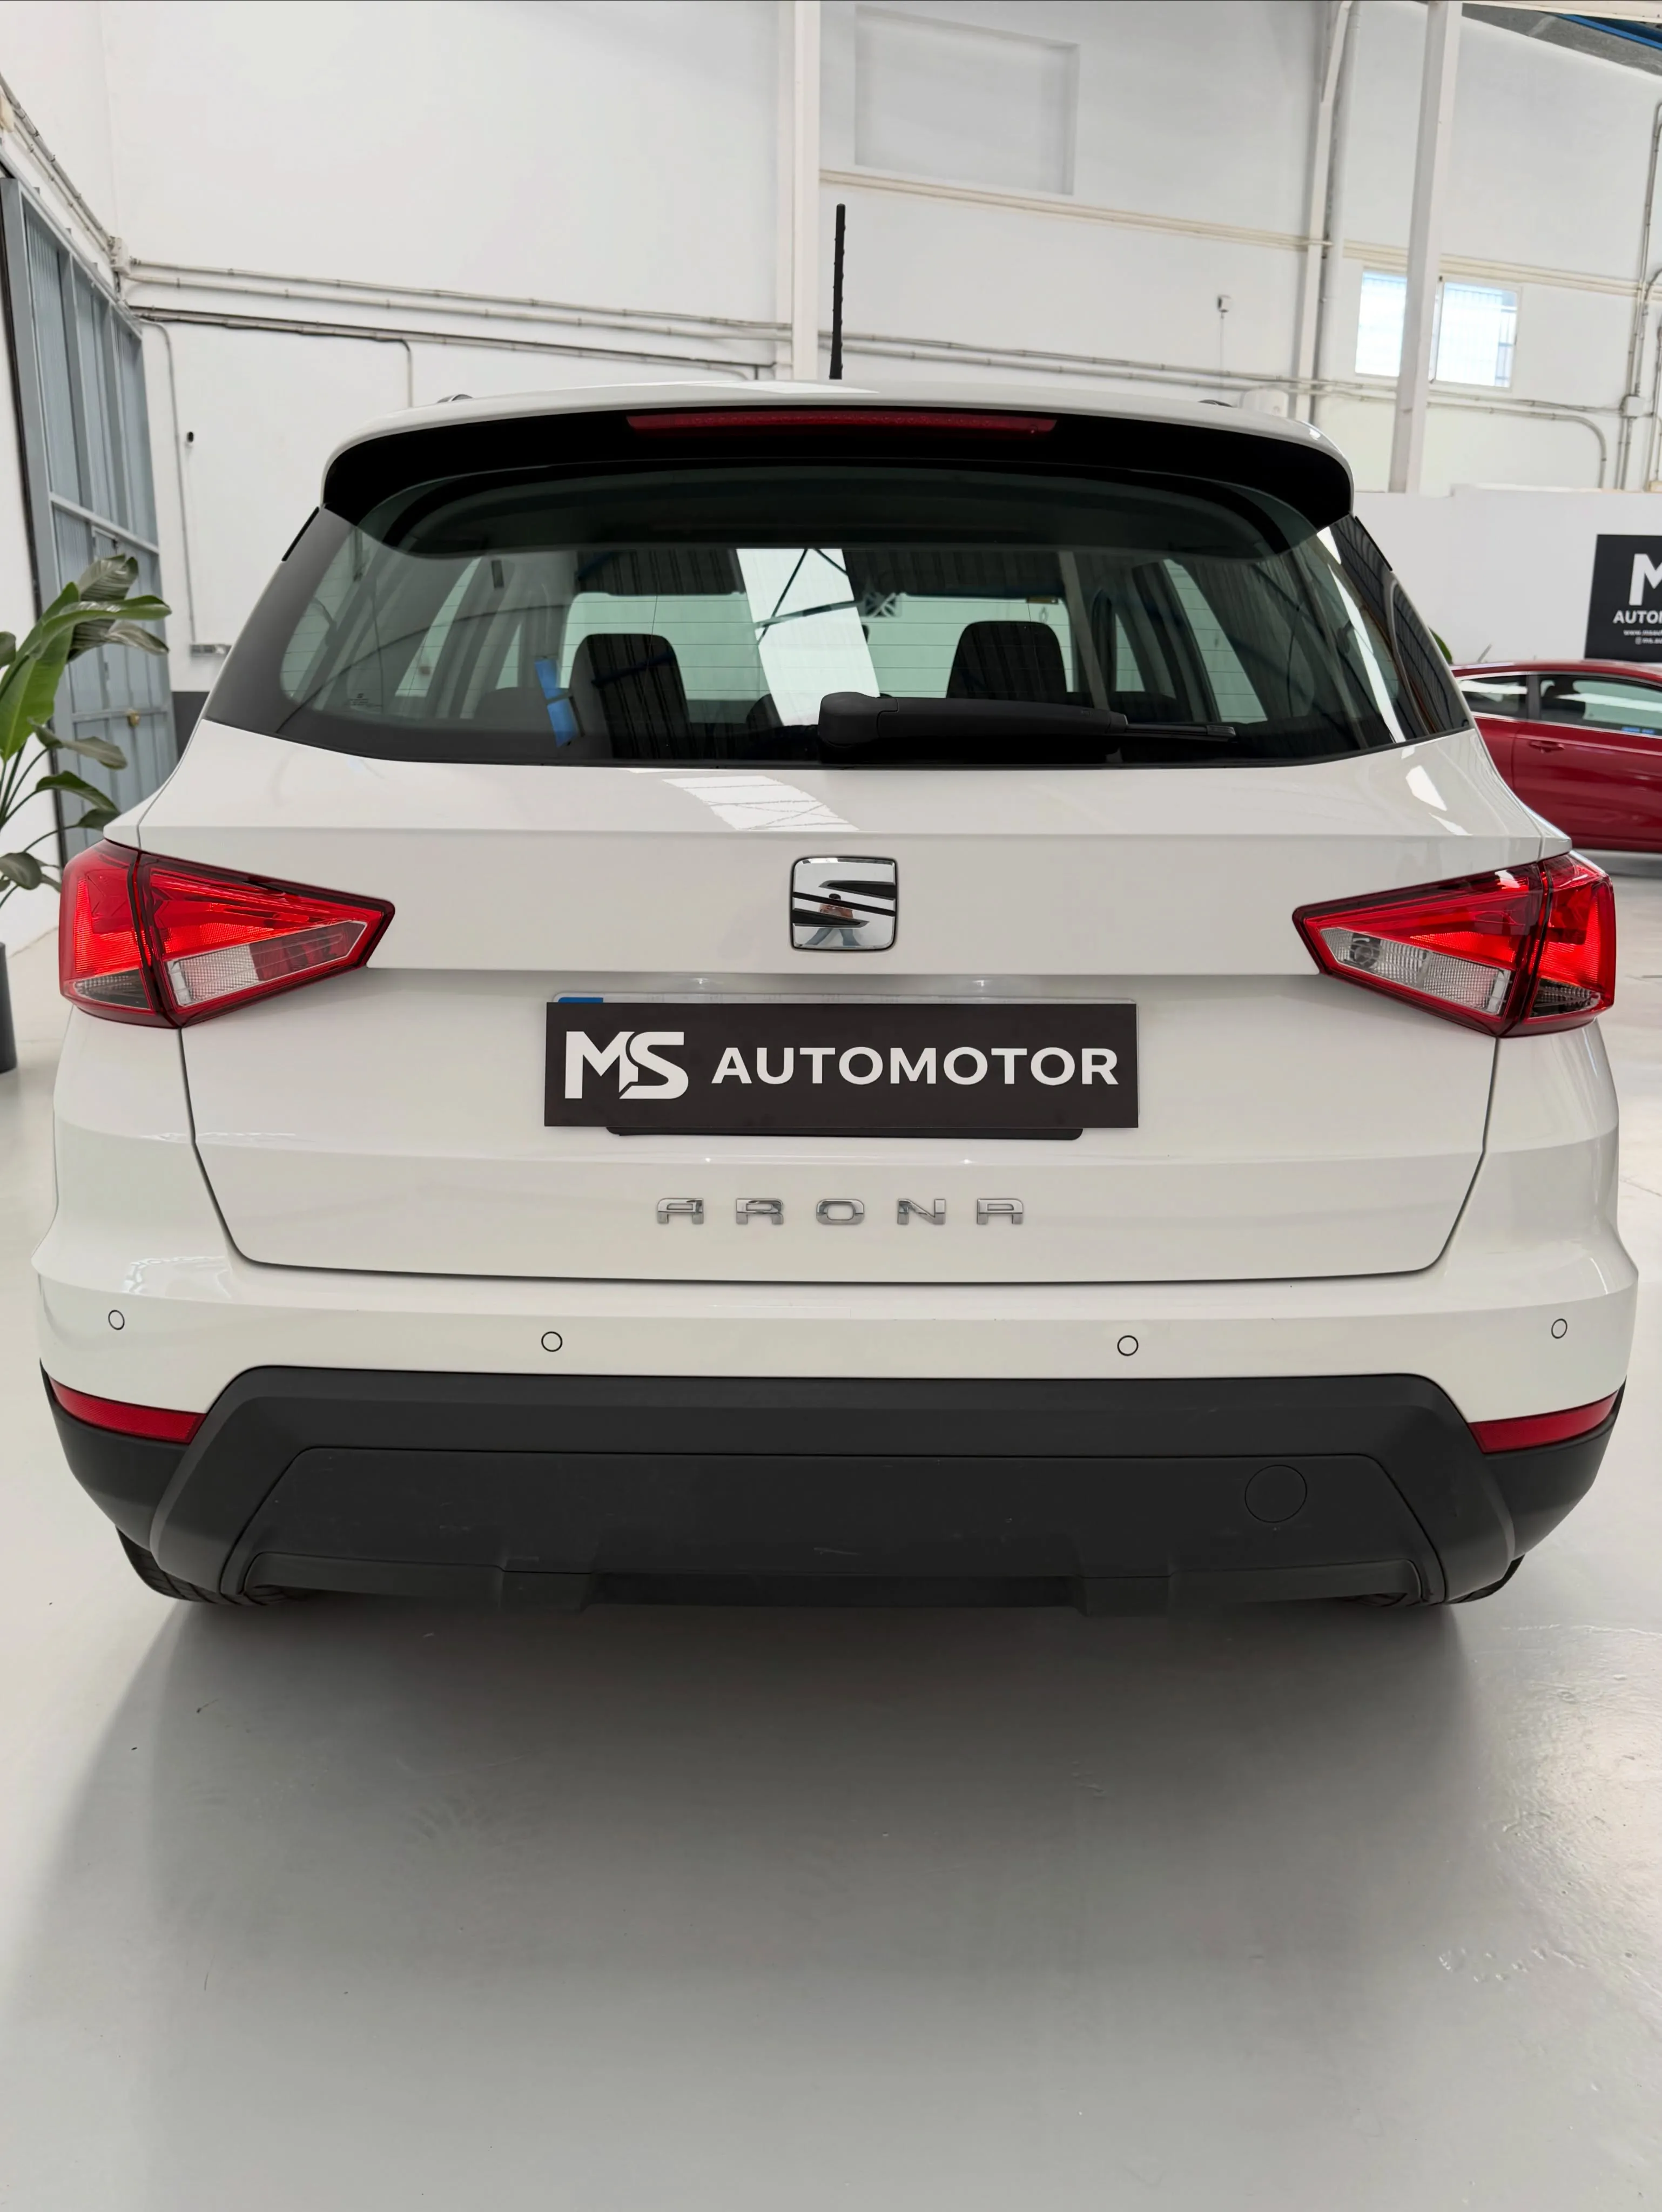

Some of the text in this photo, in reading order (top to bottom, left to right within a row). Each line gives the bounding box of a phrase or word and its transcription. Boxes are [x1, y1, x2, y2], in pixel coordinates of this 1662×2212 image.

[564, 1031, 1119, 1100] MS AUTOMOTOR
[656, 1198, 1024, 1226] ARONA
